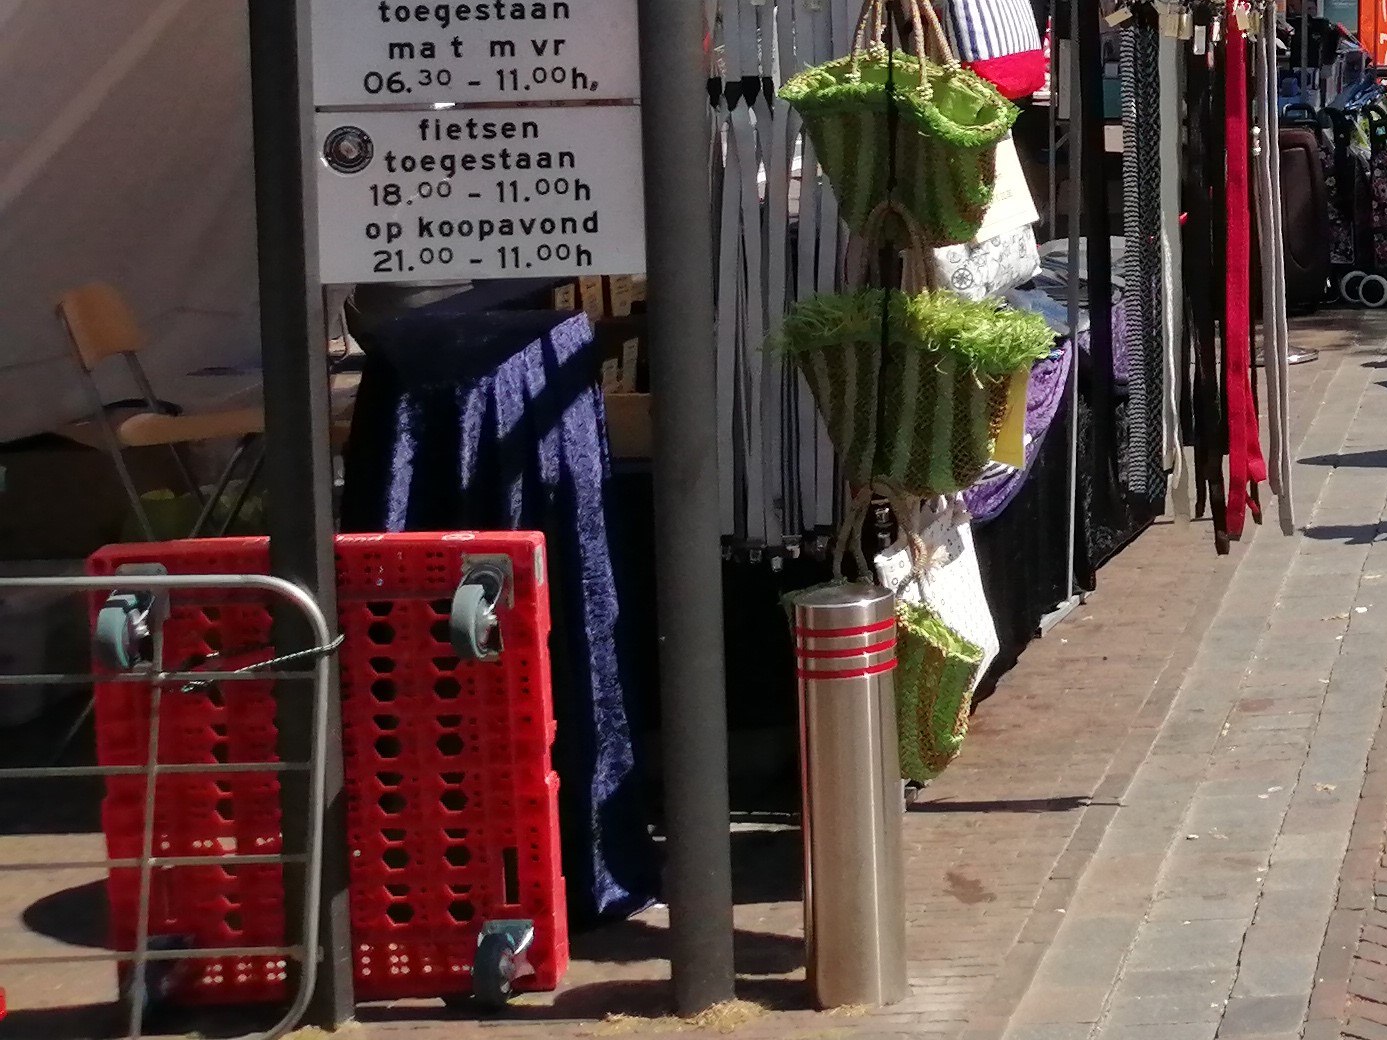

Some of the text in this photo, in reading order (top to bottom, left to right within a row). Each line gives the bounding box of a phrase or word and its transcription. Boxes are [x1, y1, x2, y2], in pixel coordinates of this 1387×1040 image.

[363, 69, 452, 94] 06.30
[419, 118, 539, 140] fietsen
[384, 148, 576, 179] toegestaan
[369, 180, 452, 207] 18.00
[496, 177, 591, 202] 11.00h
[366, 211, 599, 244] op koopavond
[373, 247, 453, 273] 21.00
[498, 243, 593, 269] 11.00h
